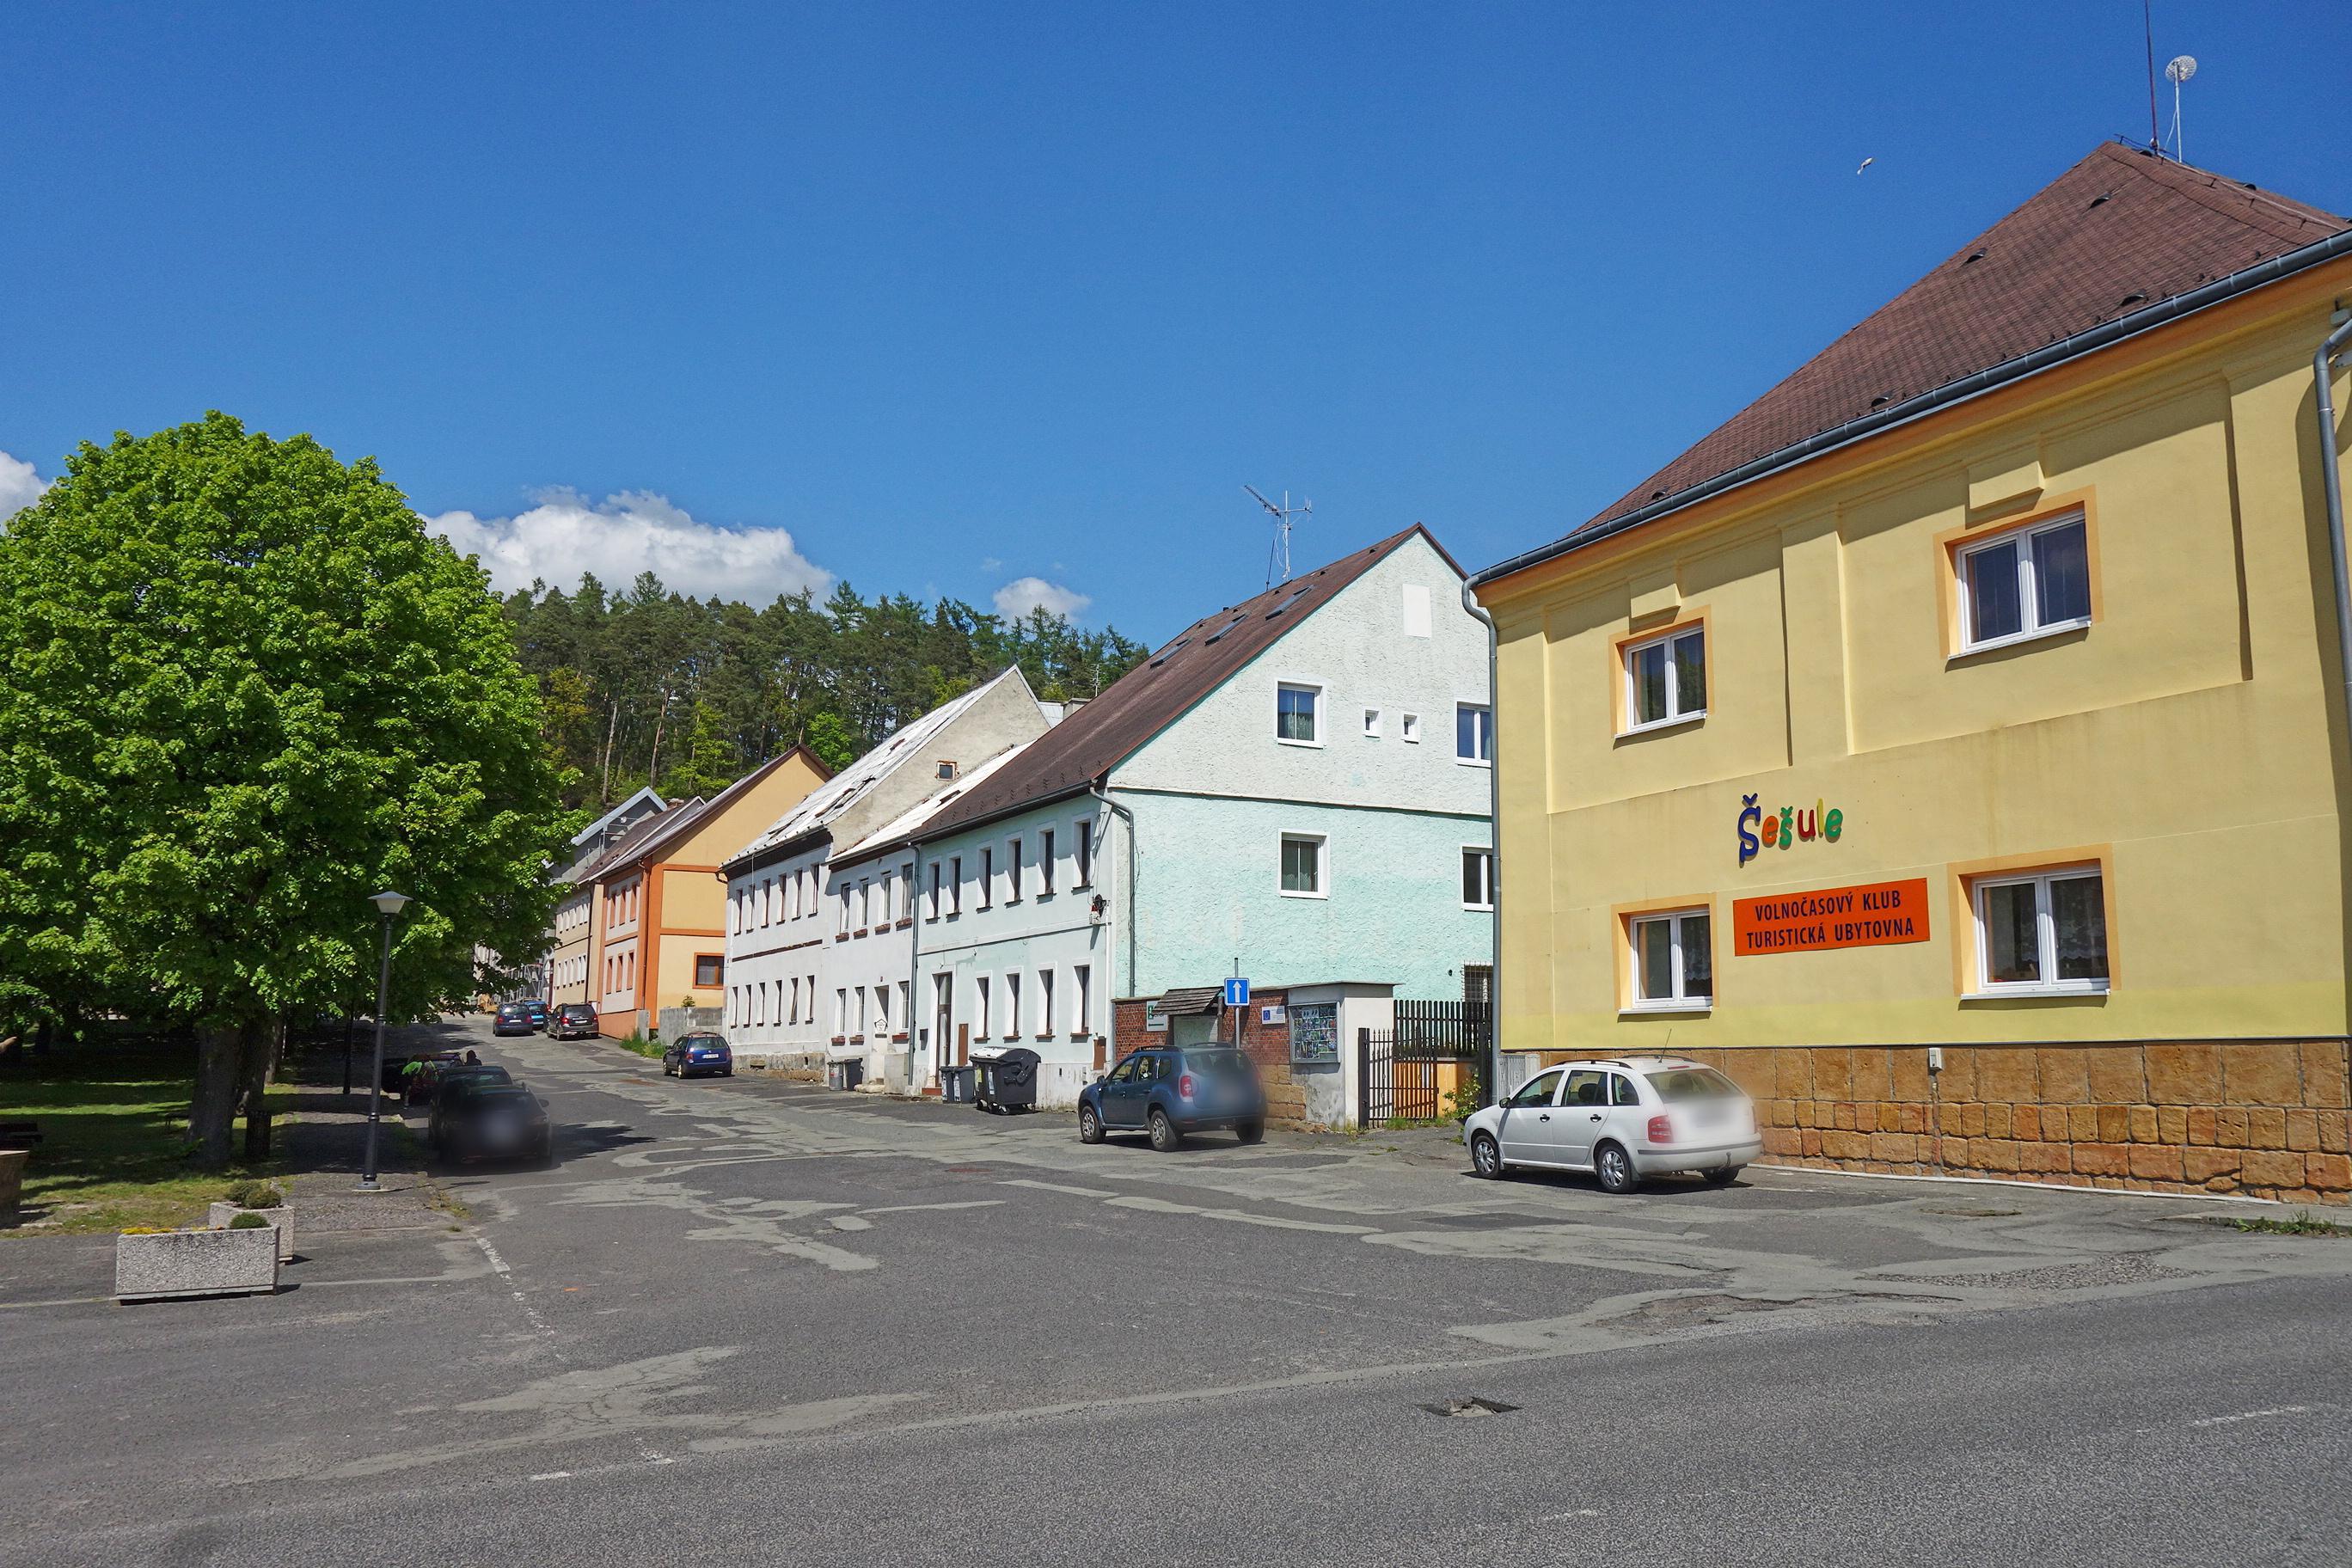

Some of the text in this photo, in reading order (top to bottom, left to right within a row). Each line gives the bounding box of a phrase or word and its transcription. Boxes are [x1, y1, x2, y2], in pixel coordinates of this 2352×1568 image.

[1737, 793, 1843, 863] Šešule
[1755, 890, 1902, 922] VOLNOČASOVÝ KLUB
[1747, 917, 1914, 949] TURISTICKÁ UBYTOVNA
